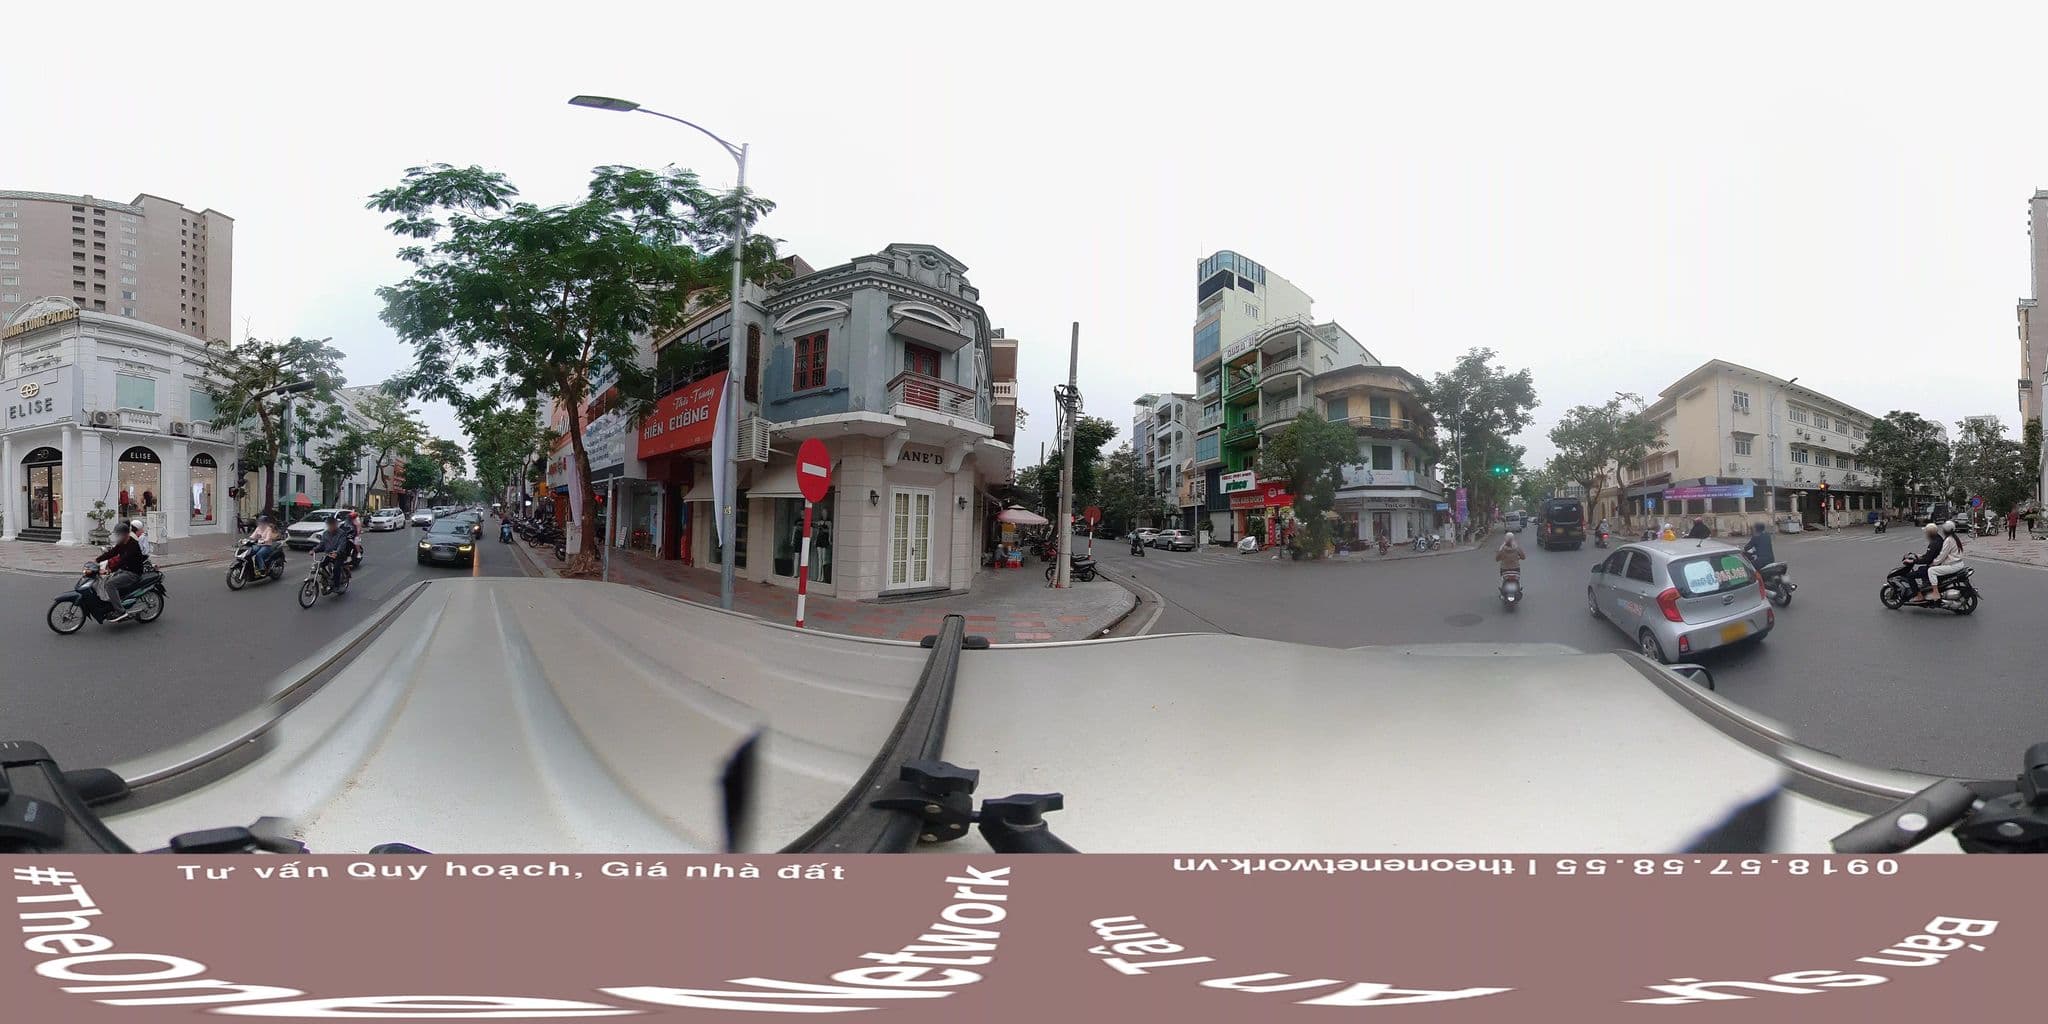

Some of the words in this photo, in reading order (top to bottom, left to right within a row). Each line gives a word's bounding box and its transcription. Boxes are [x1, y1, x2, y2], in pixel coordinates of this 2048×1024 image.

[9, 397, 52, 419] ELISE
[130, 451, 151, 460] ELISE
[898, 450, 943, 465] ANE'D
